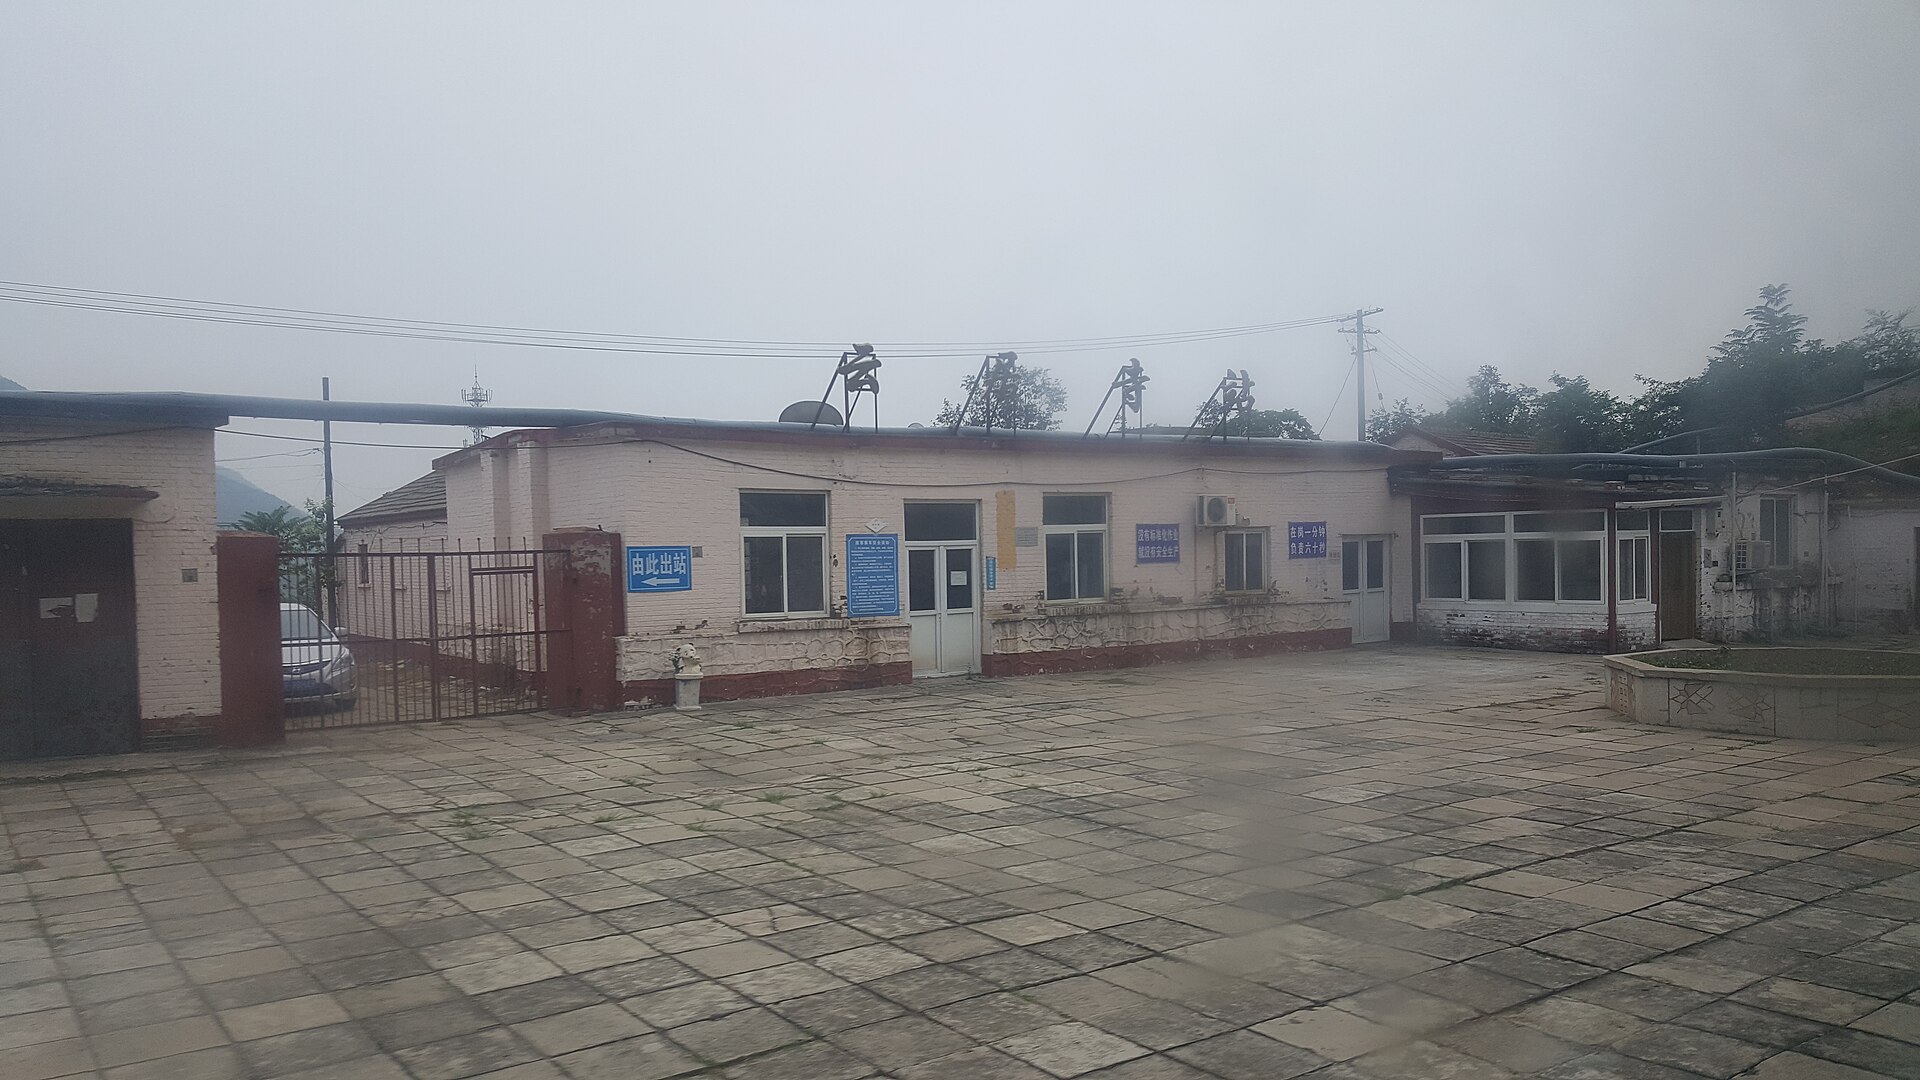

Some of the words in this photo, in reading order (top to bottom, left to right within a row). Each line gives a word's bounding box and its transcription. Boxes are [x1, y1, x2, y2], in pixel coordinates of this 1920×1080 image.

[1290, 526, 1326, 538] 在岗一分钟
[1290, 541, 1326, 555] 负责六十秒
[632, 552, 687, 575] 由此出站
